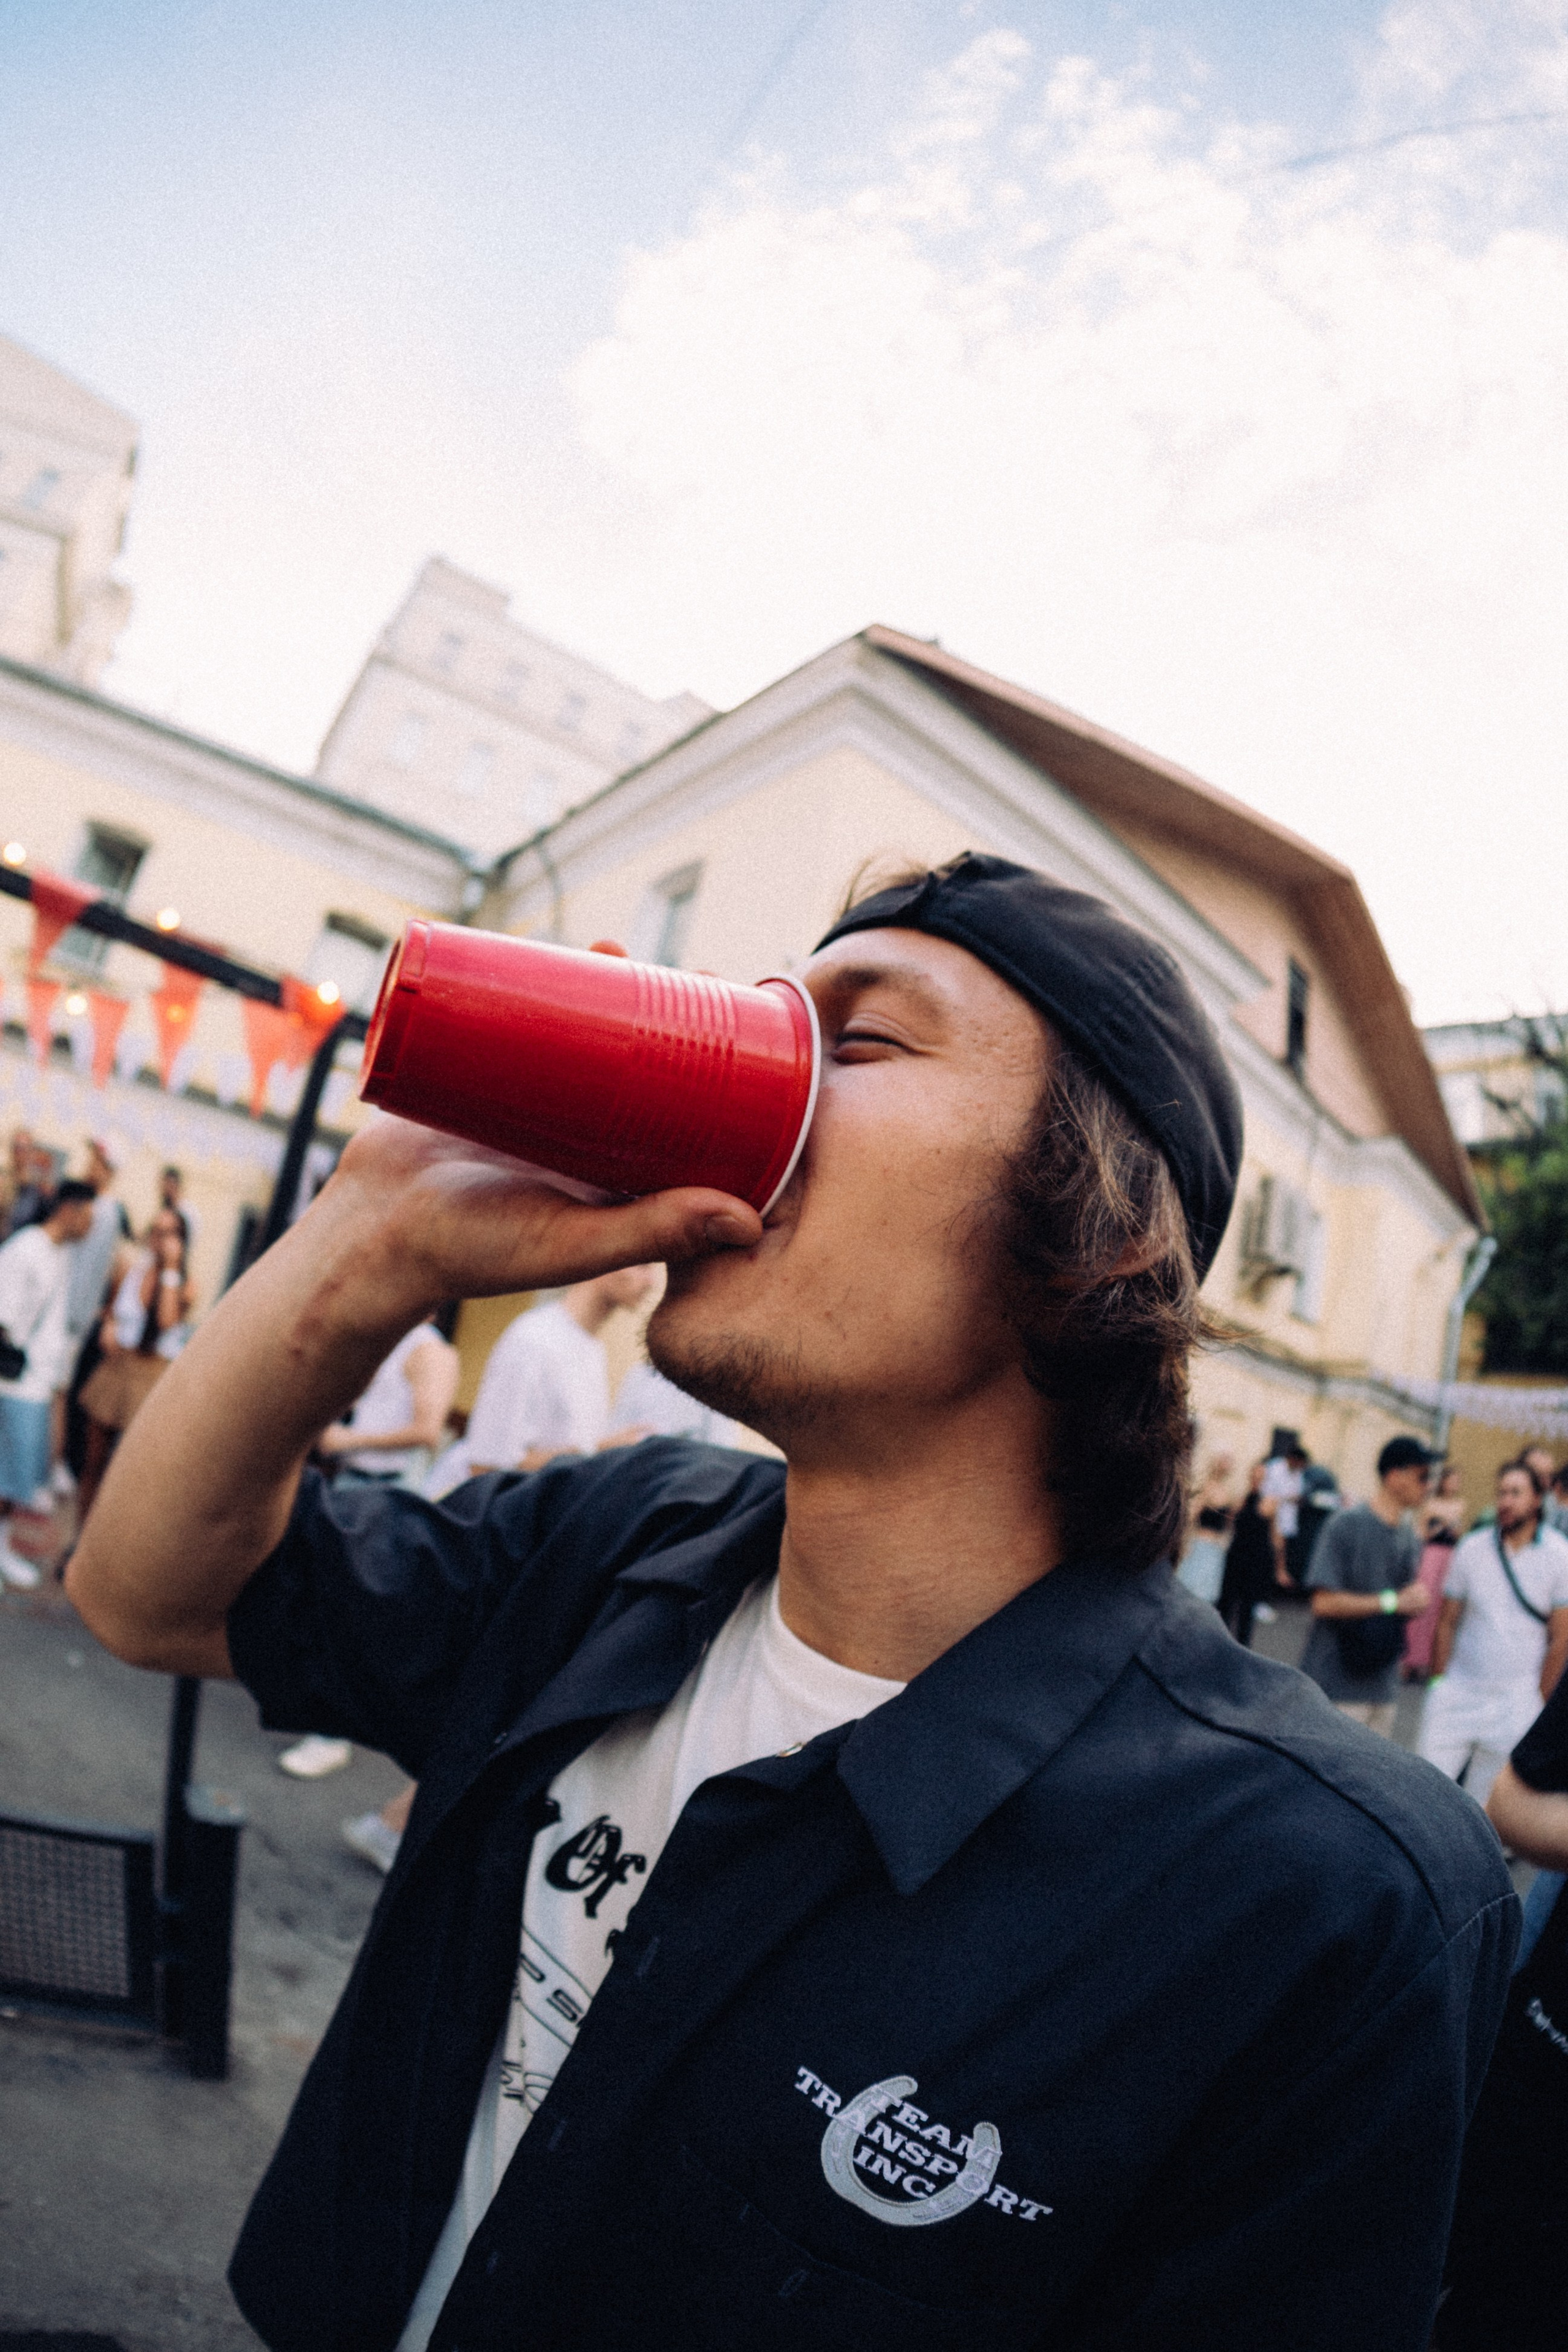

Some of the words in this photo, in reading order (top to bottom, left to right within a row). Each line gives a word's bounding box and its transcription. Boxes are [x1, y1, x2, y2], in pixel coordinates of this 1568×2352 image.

[795, 2066, 1053, 2221] TRANSPORT
[870, 2084, 1003, 2170] TEAM
[853, 2146, 935, 2198] INC
